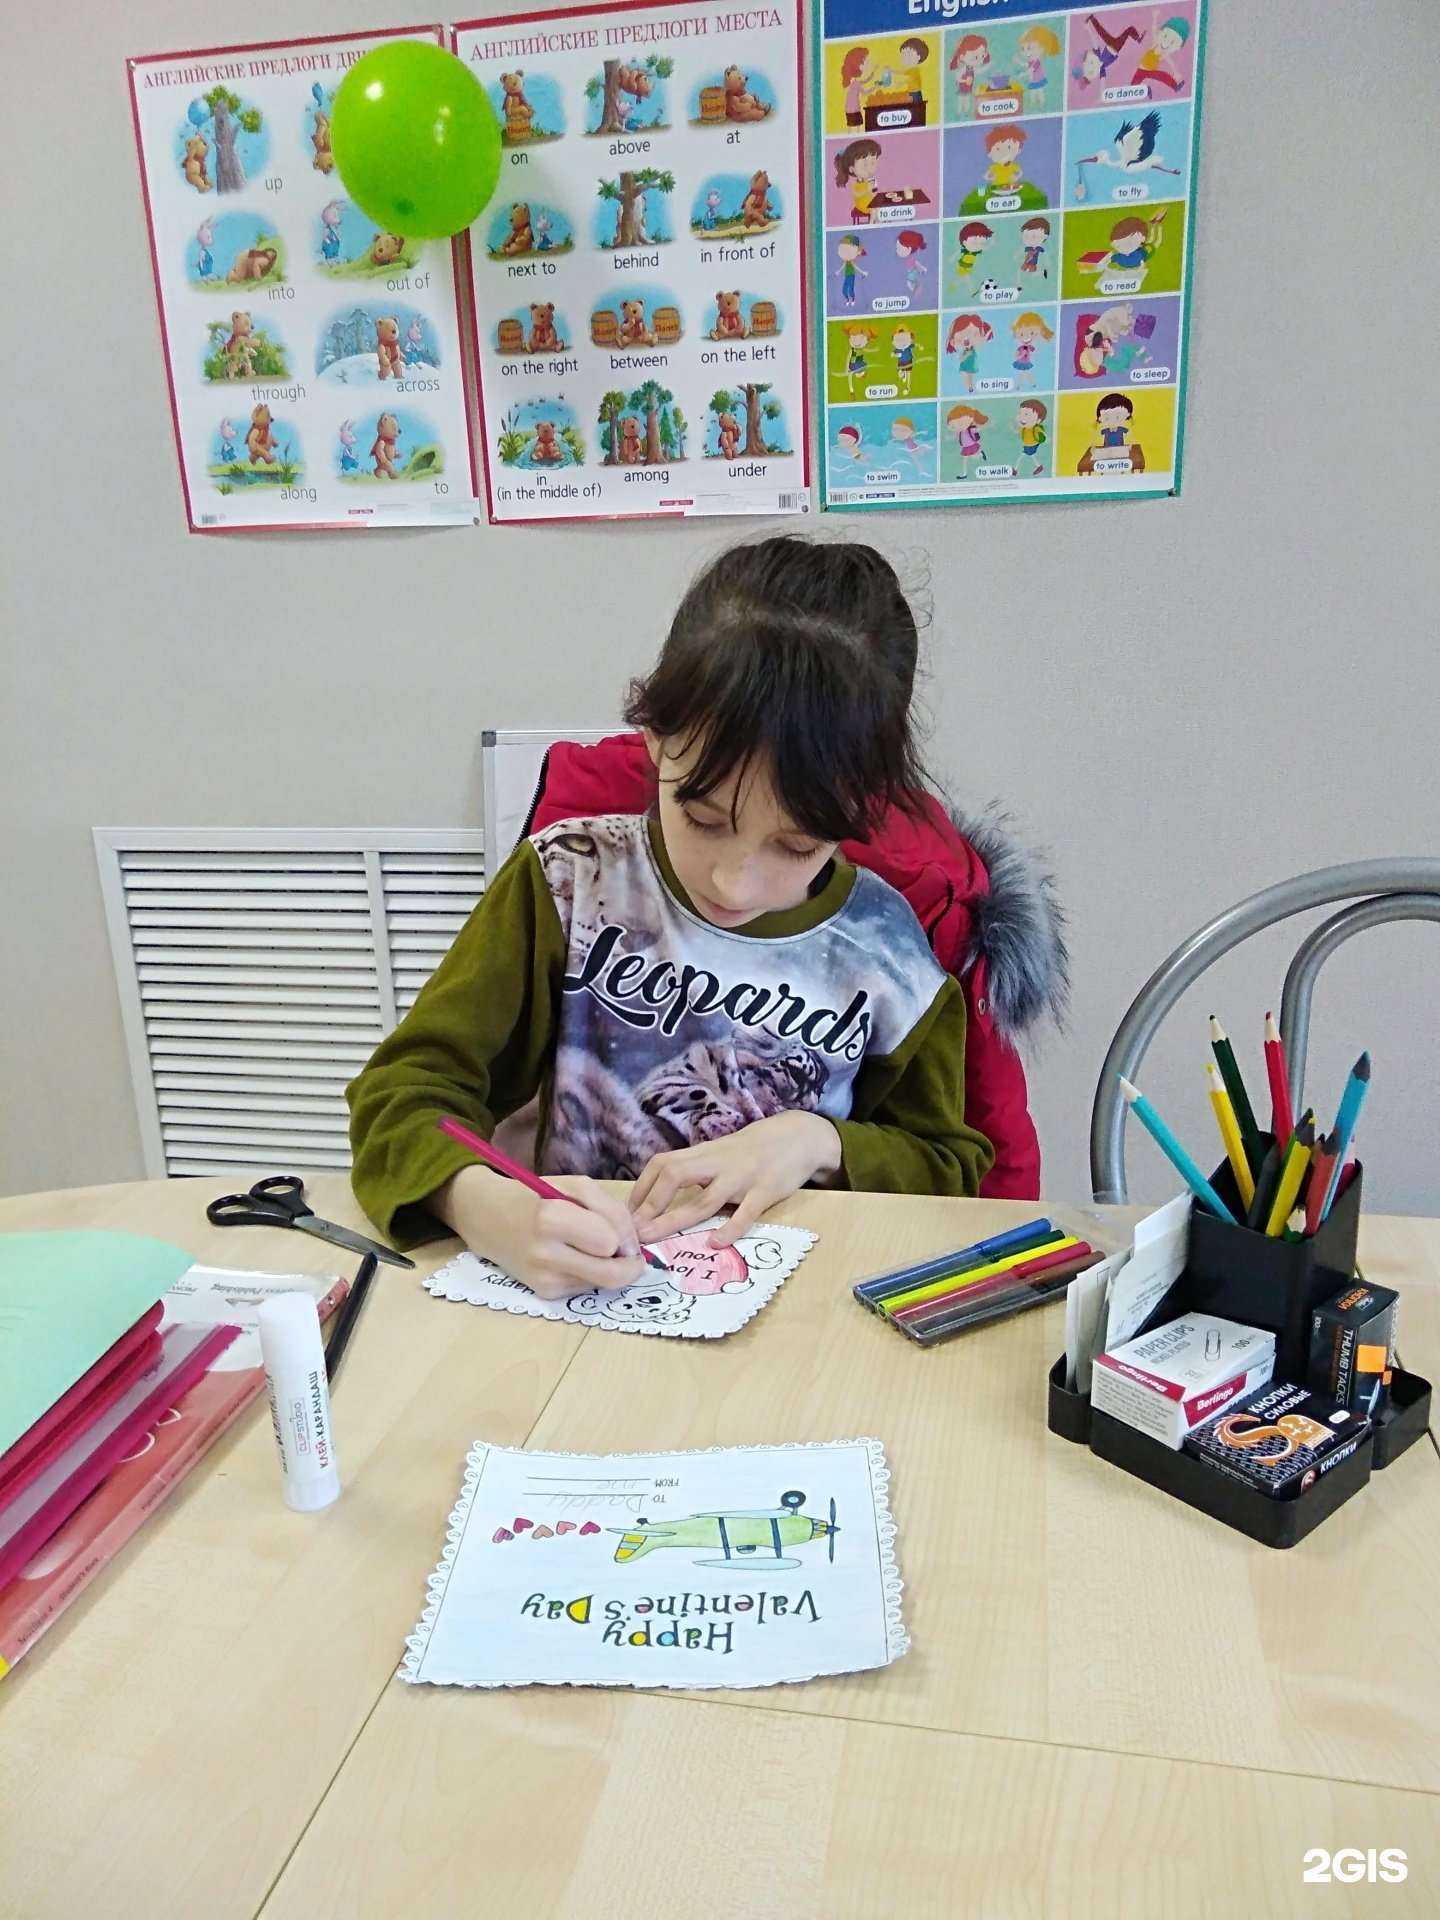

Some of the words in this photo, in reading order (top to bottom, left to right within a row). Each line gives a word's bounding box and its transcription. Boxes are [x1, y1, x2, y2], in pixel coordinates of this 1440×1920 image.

[470, 30, 599, 61] АНГЛИЙСКИЕ
[604, 17, 708, 47] ПРЕДЛОГИ
[716, 8, 784, 34] МЕСТА
[144, 62, 246, 89] АНГЛИЙСКИЕ
[249, 53, 332, 78] ПРЕДЛОГИ
[1104, 90, 1113, 99] to
[1116, 87, 1145, 98] dance
[982, 103, 991, 112] to
[994, 100, 1015, 112] cook
[880, 113, 889, 123] to
[891, 112, 908, 125] buy
[726, 130, 741, 145] at
[609, 139, 650, 156] above
[511, 152, 528, 166] on
[265, 176, 282, 192] up
[1118, 188, 1128, 197] to
[1130, 186, 1142, 198] fly
[990, 199, 999, 208] to
[1001, 198, 1016, 208] eat
[879, 208, 888, 217] to
[890, 206, 913, 217] drink
[700, 248, 712, 263] in
[719, 245, 755, 262] front
[760, 242, 776, 258] of
[614, 253, 659, 270] behind
[508, 263, 536, 278] next
[541, 262, 556, 275] to
[387, 277, 412, 292] out
[415, 273, 431, 290] of
[1104, 282, 1113, 291] to
[1115, 280, 1136, 290] read
[268, 286, 295, 301] into
[984, 291, 993, 300] to
[996, 290, 1014, 302] play
[875, 299, 883, 308] to
[885, 298, 907, 310] jump
[610, 354, 668, 370] between
[701, 352, 718, 364] on
[724, 348, 746, 363] the
[752, 347, 776, 361] left
[501, 364, 518, 376] on
[523, 360, 544, 375] the
[548, 358, 578, 376] right
[1132, 370, 1142, 380] to
[1144, 368, 1168, 382] sleep
[396, 378, 440, 392] across
[868, 388, 877, 396] to
[880, 388, 893, 396] run
[980, 381, 990, 389] to
[992, 379, 1009, 391] sing
[251, 384, 306, 402] through
[728, 464, 767, 478] under
[979, 467, 988, 476] to
[990, 465, 1009, 476] walk
[1096, 462, 1105, 471] to
[1107, 460, 1129, 471] write
[536, 473, 547, 486] in
[624, 470, 669, 485] among
[867, 473, 876, 482] to
[877, 472, 898, 481] swim
[280, 486, 317, 502] along
[434, 482, 449, 494] to
[497, 486, 512, 500] (in
[516, 485, 536, 499] the
[540, 484, 578, 499] middle
[583, 482, 602, 498] of)
[564, 926, 871, 1062] Leopards
[673, 1250, 719, 1263] you!
[656, 1264, 695, 1277] lov
[701, 1270, 719, 1280] I
[1134, 1336, 1167, 1358] PAPER
[1165, 1324, 1195, 1346] CLIPS
[1339, 1329, 1353, 1370] THUMB
[1118, 1365, 1168, 1393] Berlingo
[1336, 1369, 1349, 1404] TACKS
[1197, 1387, 1234, 1411] Berlingo
[1248, 1383, 1298, 1414] КНОПКИ
[1264, 1389, 1312, 1420] СИЛОВЫЕ
[1320, 1442, 1357, 1474] КНОПКИ
[654, 1478, 681, 1488] FROM
[653, 1494, 666, 1503] TO
[521, 1592, 591, 1625] Day
[604, 1589, 823, 1623] Valentine's
[602, 1621, 735, 1655] Happy
